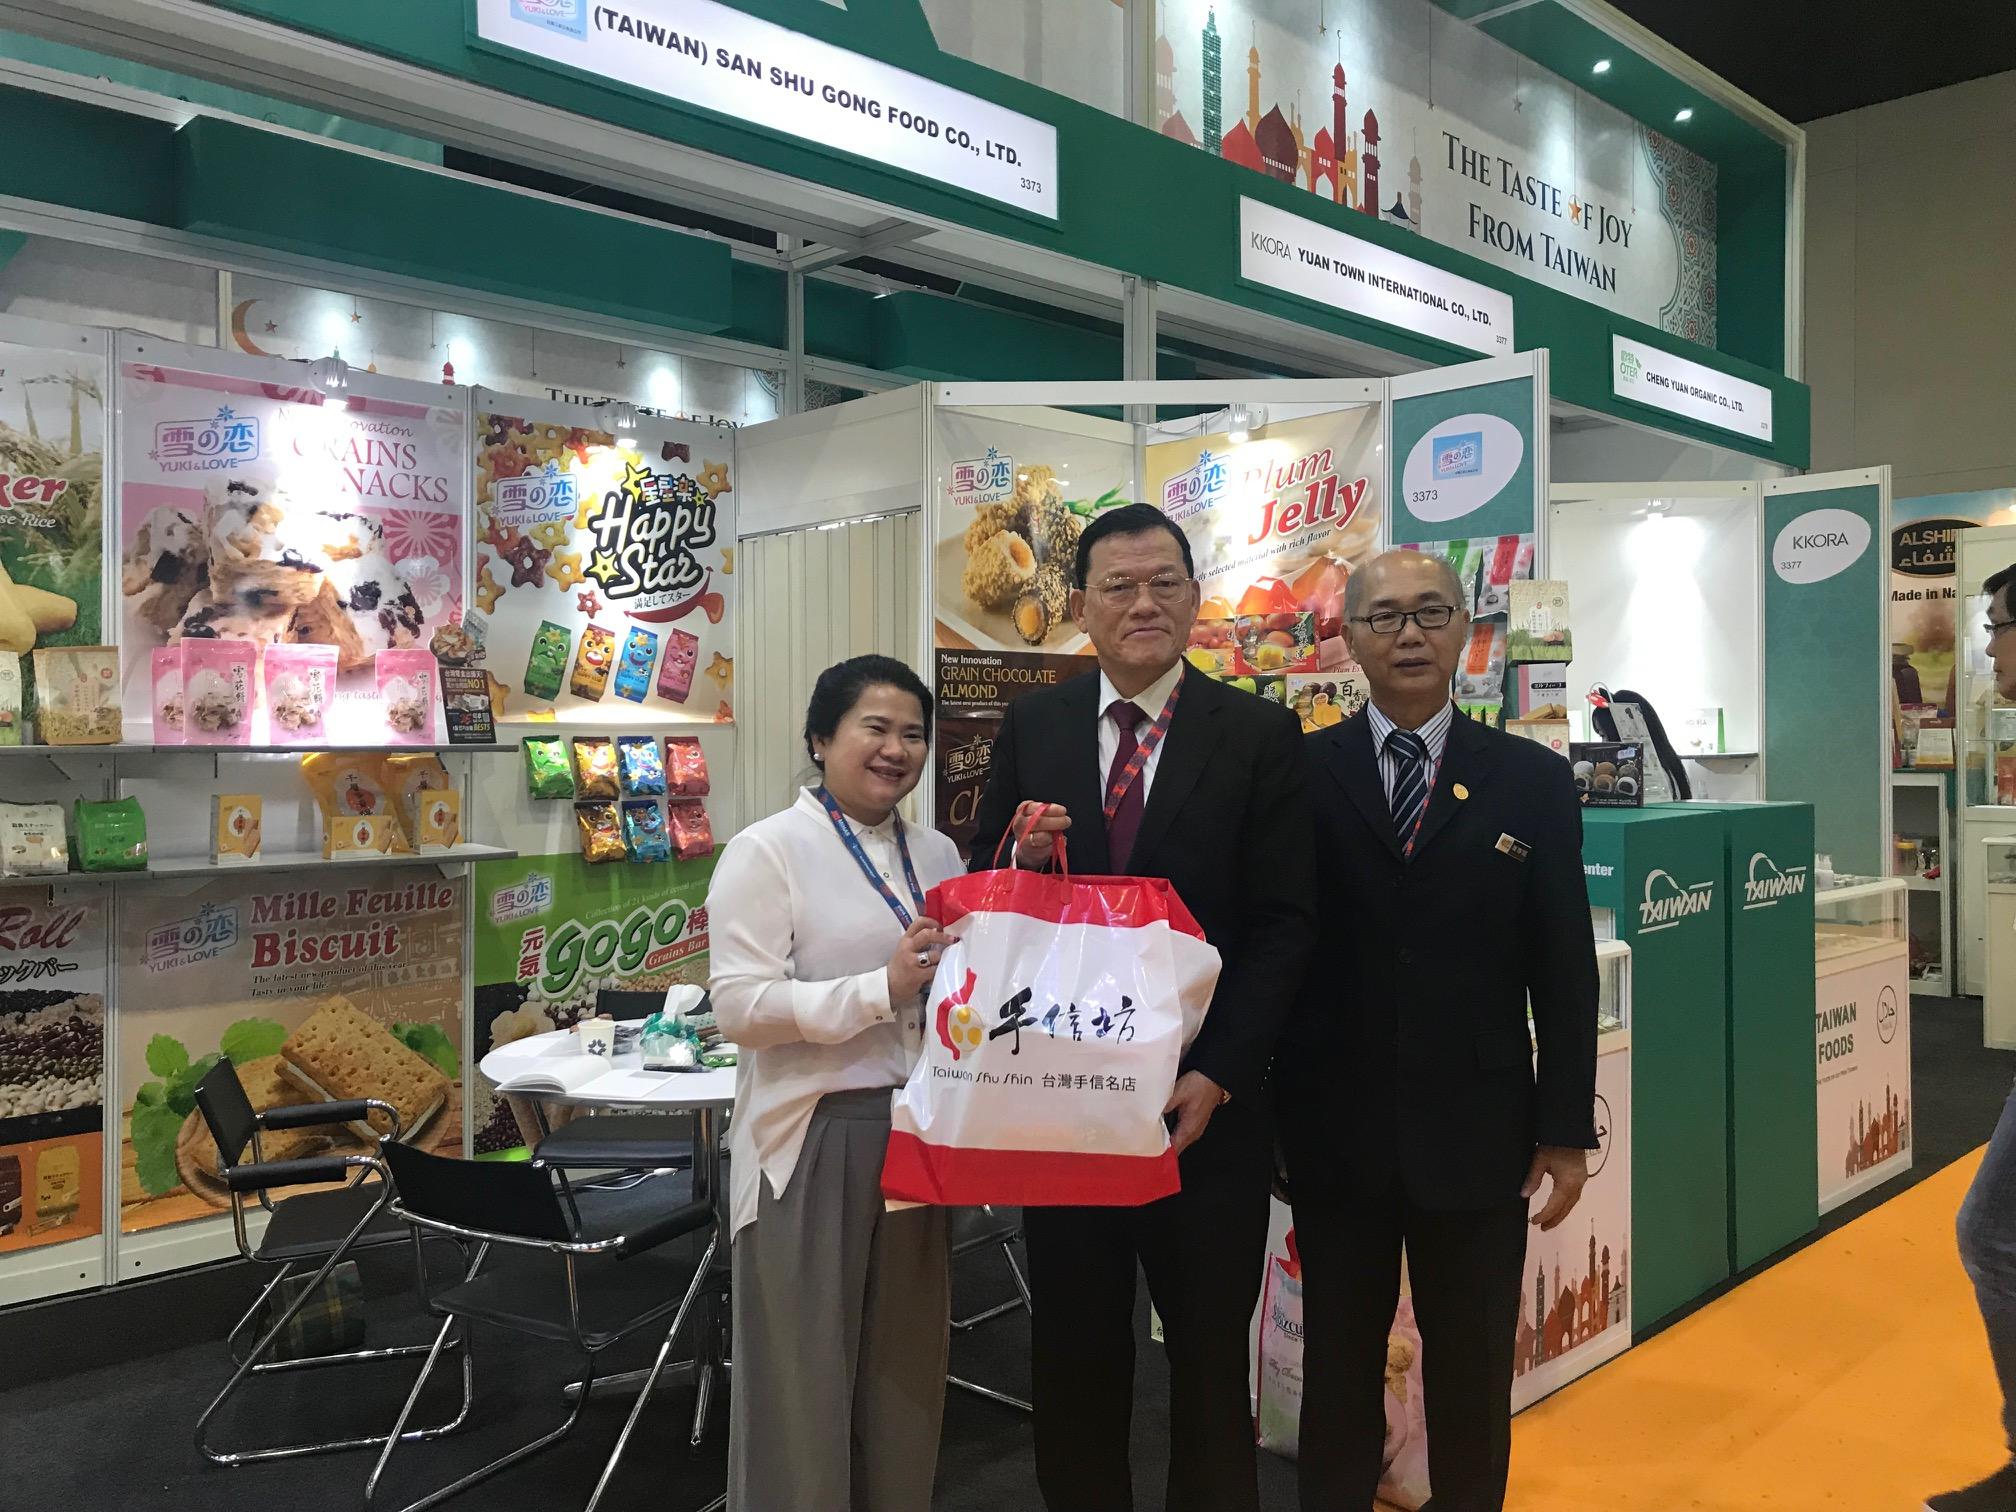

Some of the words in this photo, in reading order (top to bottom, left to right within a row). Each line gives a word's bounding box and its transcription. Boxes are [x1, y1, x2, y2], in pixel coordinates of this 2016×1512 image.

[594, 6, 708, 65] (TAIWAN)
[716, 49, 761, 79] SAN
[770, 67, 814, 96] SHU
[822, 85, 881, 118] GONG
[888, 106, 939, 138] FOOD
[945, 127, 980, 156] CO.,
[986, 140, 1022, 167] LTD.
[1020, 178, 1042, 194] 3373
[1442, 131, 1491, 187] THE
[1497, 157, 1562, 218] TASTE
[1598, 205, 1632, 248] JOY
[1469, 202, 1534, 261] FROM
[1540, 232, 1616, 294] TAIWAN
[1251, 232, 1292, 260] KKORA
[1298, 248, 1330, 271] YUAN
[1333, 260, 1365, 283] TOWN
[1368, 272, 1449, 311] INTERNATIONAL
[1451, 301, 1470, 321] CO.,
[1472, 310, 1491, 326] LTD.
[1646, 371, 1669, 388] CHENG
[1671, 380, 1689, 394] YUAN
[1690, 386, 1718, 404] ORGANIC
[162, 422, 254, 458] 雪の恋
[955, 462, 1010, 492] 雪の恋
[1167, 463, 1226, 511] 雪の恋
[502, 479, 573, 511] 雪の恋
[1248, 474, 1367, 545] Jelly
[1412, 489, 1438, 502] 3373
[594, 495, 712, 549] Happy
[1209, 561, 1236, 577] selected
[1271, 542, 1287, 555] with
[1289, 536, 1305, 550] rich
[1305, 528, 1332, 546] flavor
[1793, 532, 1848, 550] KKORA
[608, 544, 698, 597] Star
[1781, 561, 1802, 570] 3377
[1926, 587, 1938, 600] in
[941, 654, 958, 664] New
[960, 654, 1002, 666] Innovation
[941, 666, 979, 682] GRAIN
[982, 667, 1056, 684] CHOCOLATE
[941, 684, 998, 699] ALMOND
[251, 890, 337, 924] Mille
[345, 882, 453, 917] Feuille
[496, 881, 549, 914] 雪の恋
[1745, 873, 1805, 902] TAIWAN
[1639, 889, 1712, 925] TAIWAN
[151, 914, 234, 959] 雪の恋
[251, 921, 399, 969] Biscuit
[541, 905, 687, 993] gogo
[648, 946, 684, 967] Grains
[253, 974, 271, 985] The
[319, 967, 355, 979] product
[989, 986, 1137, 1056] 手信坊
[1816, 1001, 1857, 1034] TAIWAN
[1818, 1033, 1854, 1065] FOODS
[932, 1066, 972, 1082] Taiwan
[1041, 1073, 1137, 1093] 台灣手信名店
